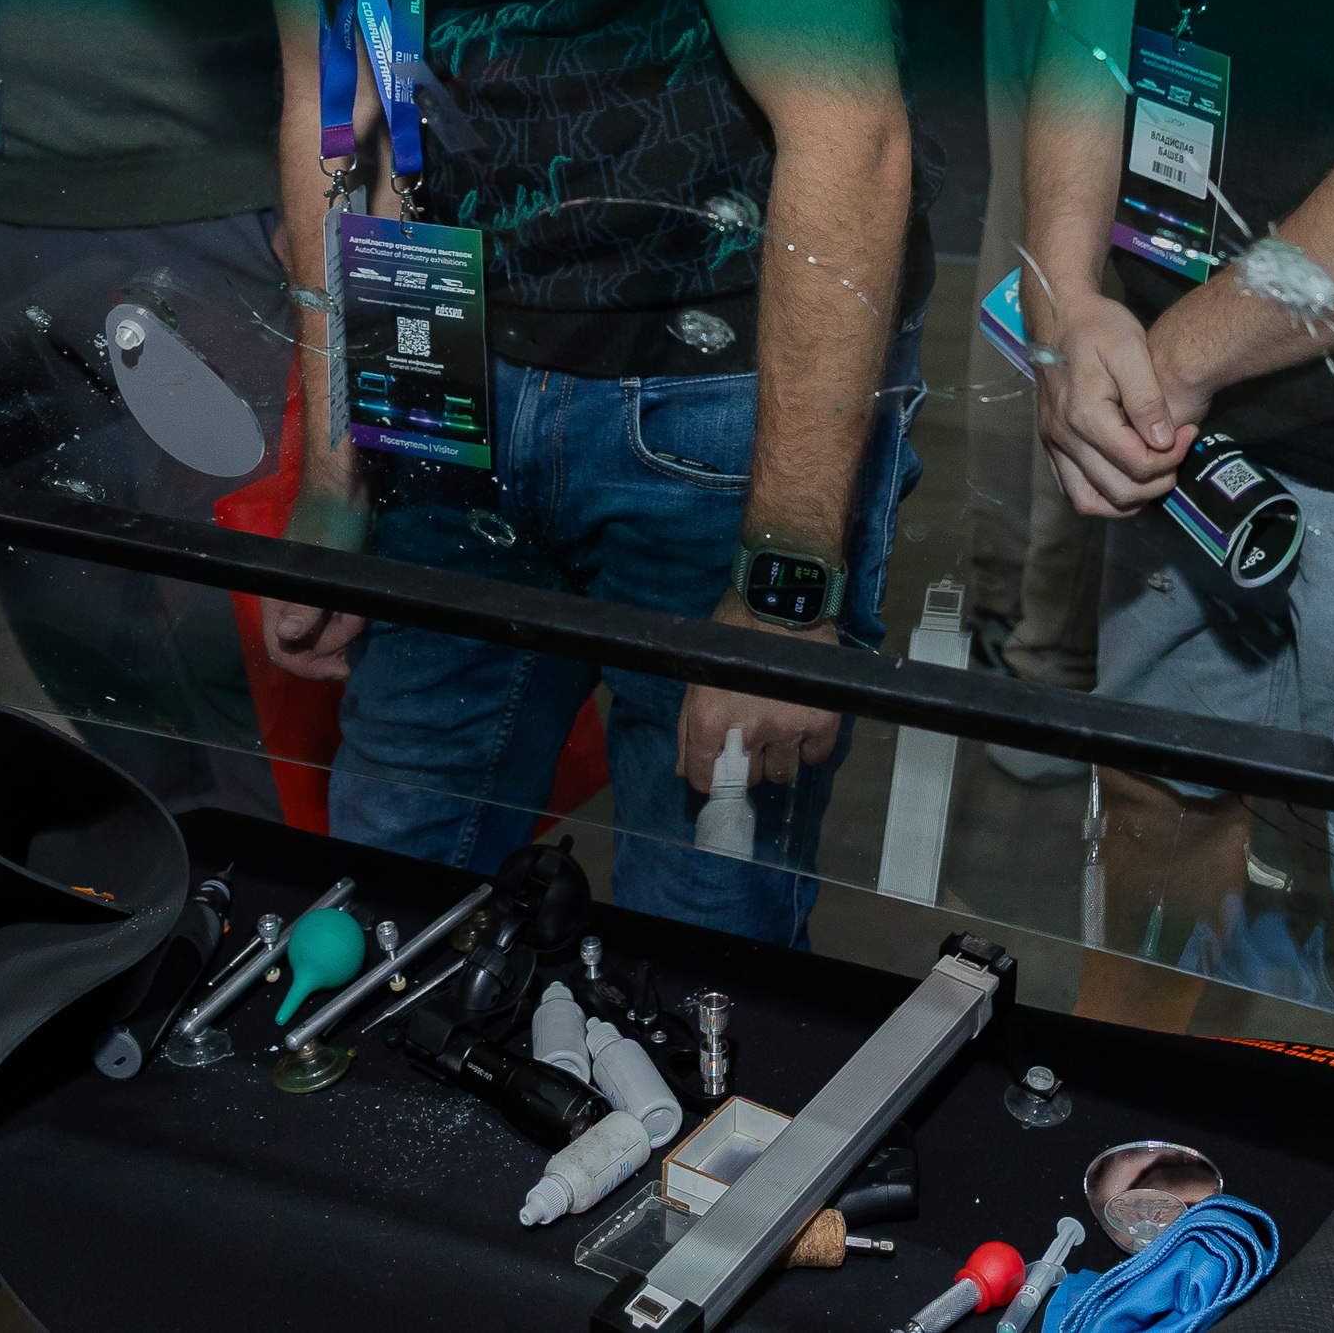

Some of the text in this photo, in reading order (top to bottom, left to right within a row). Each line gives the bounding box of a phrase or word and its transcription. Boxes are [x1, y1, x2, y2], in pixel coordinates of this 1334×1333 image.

[1150, 130, 1195, 155] ВЛАДИСЛАВ
[1158, 146, 1185, 164] БАШЕВ
[380, 434, 428, 451] Посетитель
[433, 444, 459, 456] Visitor
